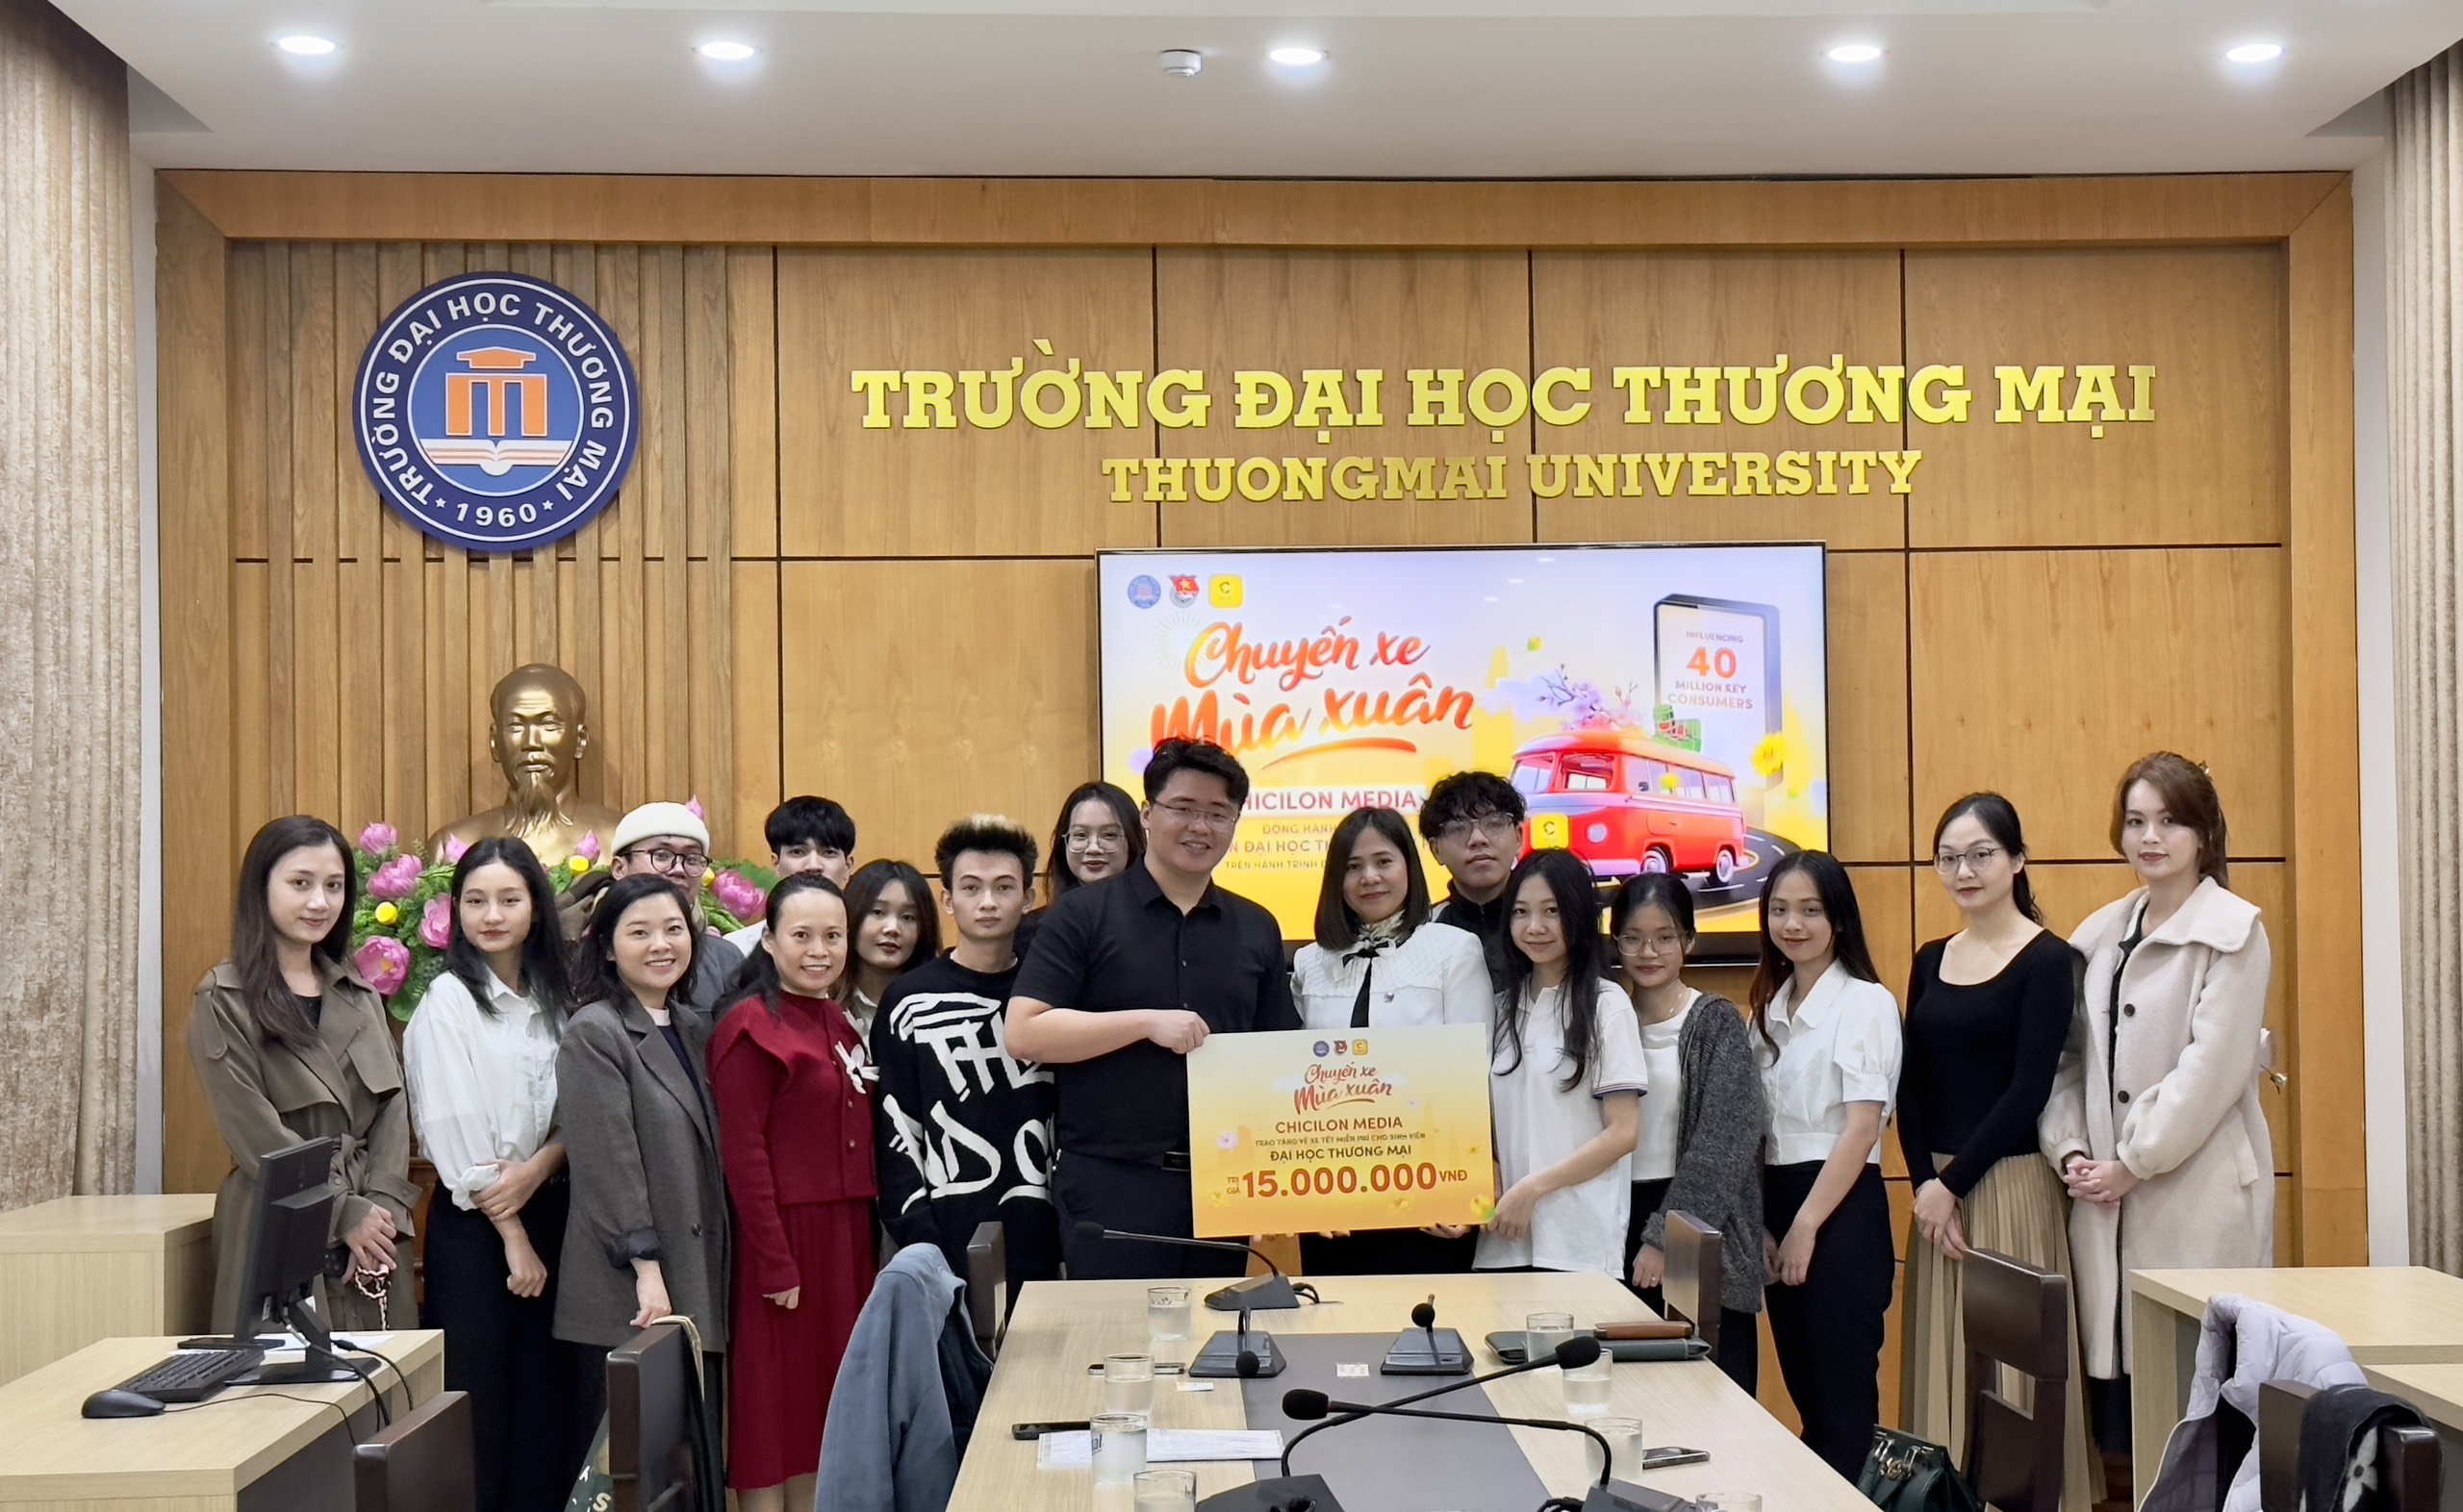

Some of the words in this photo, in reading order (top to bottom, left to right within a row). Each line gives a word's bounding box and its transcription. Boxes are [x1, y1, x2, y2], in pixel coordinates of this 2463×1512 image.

[447, 291, 521, 322] HỌC
[388, 310, 442, 364] ĐẠI
[535, 302, 614, 429] THƯƠNG
[851, 339, 1212, 430] TRƯỜNG
[1232, 367, 1384, 444] ĐẠI
[1406, 365, 1592, 444] HỌC
[1612, 353, 1971, 426] THƯƠNG
[1993, 364, 2157, 439] MẠI
[371, 371, 435, 506] TRƯỜNG
[555, 440, 607, 501] MẠI
[1102, 455, 1507, 503] THUONGMAI
[1526, 450, 1922, 499] UNIVERSITY
[456, 502, 537, 527] 1960
[1686, 630, 1744, 643] INFLUENCING
[1184, 616, 1359, 692] Chuyến
[1369, 631, 1432, 667] xe
[1686, 645, 1738, 679] 40
[1317, 671, 1475, 736] xuân
[1667, 693, 1754, 710] CONSUMERS
[1675, 680, 1722, 693] MILLION
[1725, 683, 1747, 693] KEY
[1341, 790, 1417, 809] MEDIA
[1244, 840, 1271, 856] ĐẠI
[1276, 840, 1310, 856] HỌC
[1305, 1061, 1358, 1085] Chuyến
[1359, 1066, 1377, 1076] xe
[1293, 1084, 1342, 1115] Mùa
[1346, 1078, 1392, 1096] xuân
[1275, 1119, 1349, 1134] CHICILON
[1353, 1117, 1403, 1130] MEDIA
[1270, 1149, 1292, 1164] ĐẠI
[1295, 1148, 1325, 1163] HỌC
[1328, 1146, 1384, 1159] THƯƠNG
[1386, 1145, 1411, 1158] MẠI
[1242, 1161, 1437, 1198] 15.000.000
[1438, 1169, 1468, 1183] VNĐ
